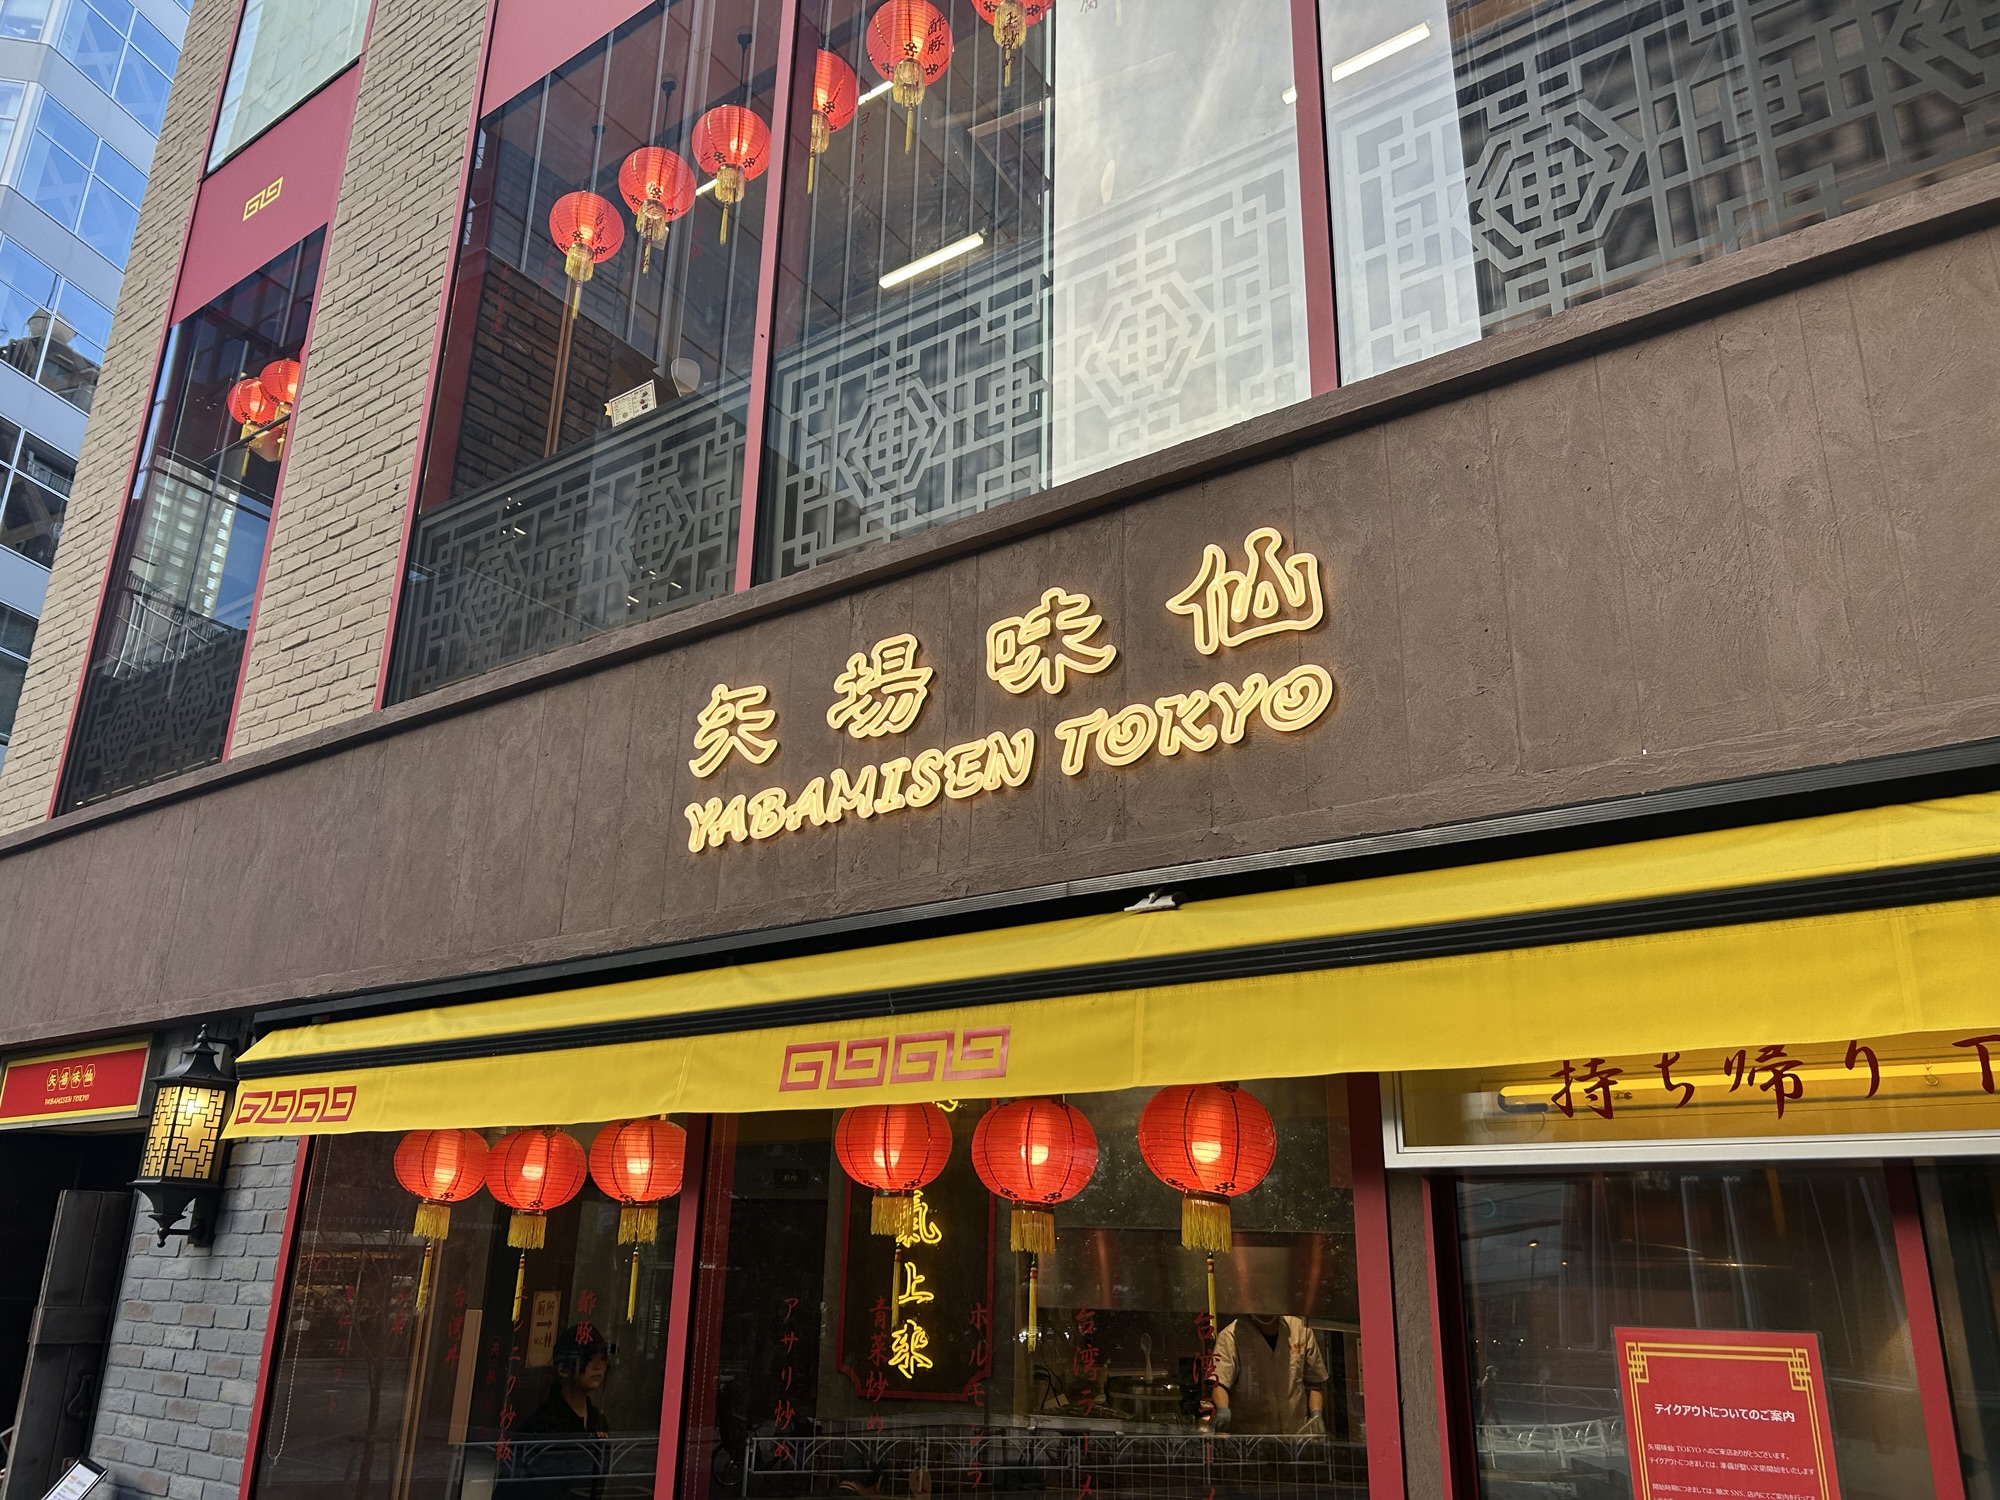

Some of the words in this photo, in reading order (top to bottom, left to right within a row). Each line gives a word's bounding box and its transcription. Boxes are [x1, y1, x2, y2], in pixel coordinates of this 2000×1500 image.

[685, 728, 1036, 853] YABAMISEN
[1055, 664, 1334, 776] TOKYO
[1550, 1039, 1881, 1120] 持ち帰り
[576, 1288, 597, 1345] 酢豚
[774, 1297, 799, 1462] アサリ炒め
[866, 1296, 892, 1434] 青菜炒め
[1654, 1403, 1796, 1423] テイクアウトについてのご案内
[1676, 1445, 1702, 1454] TOKYO
